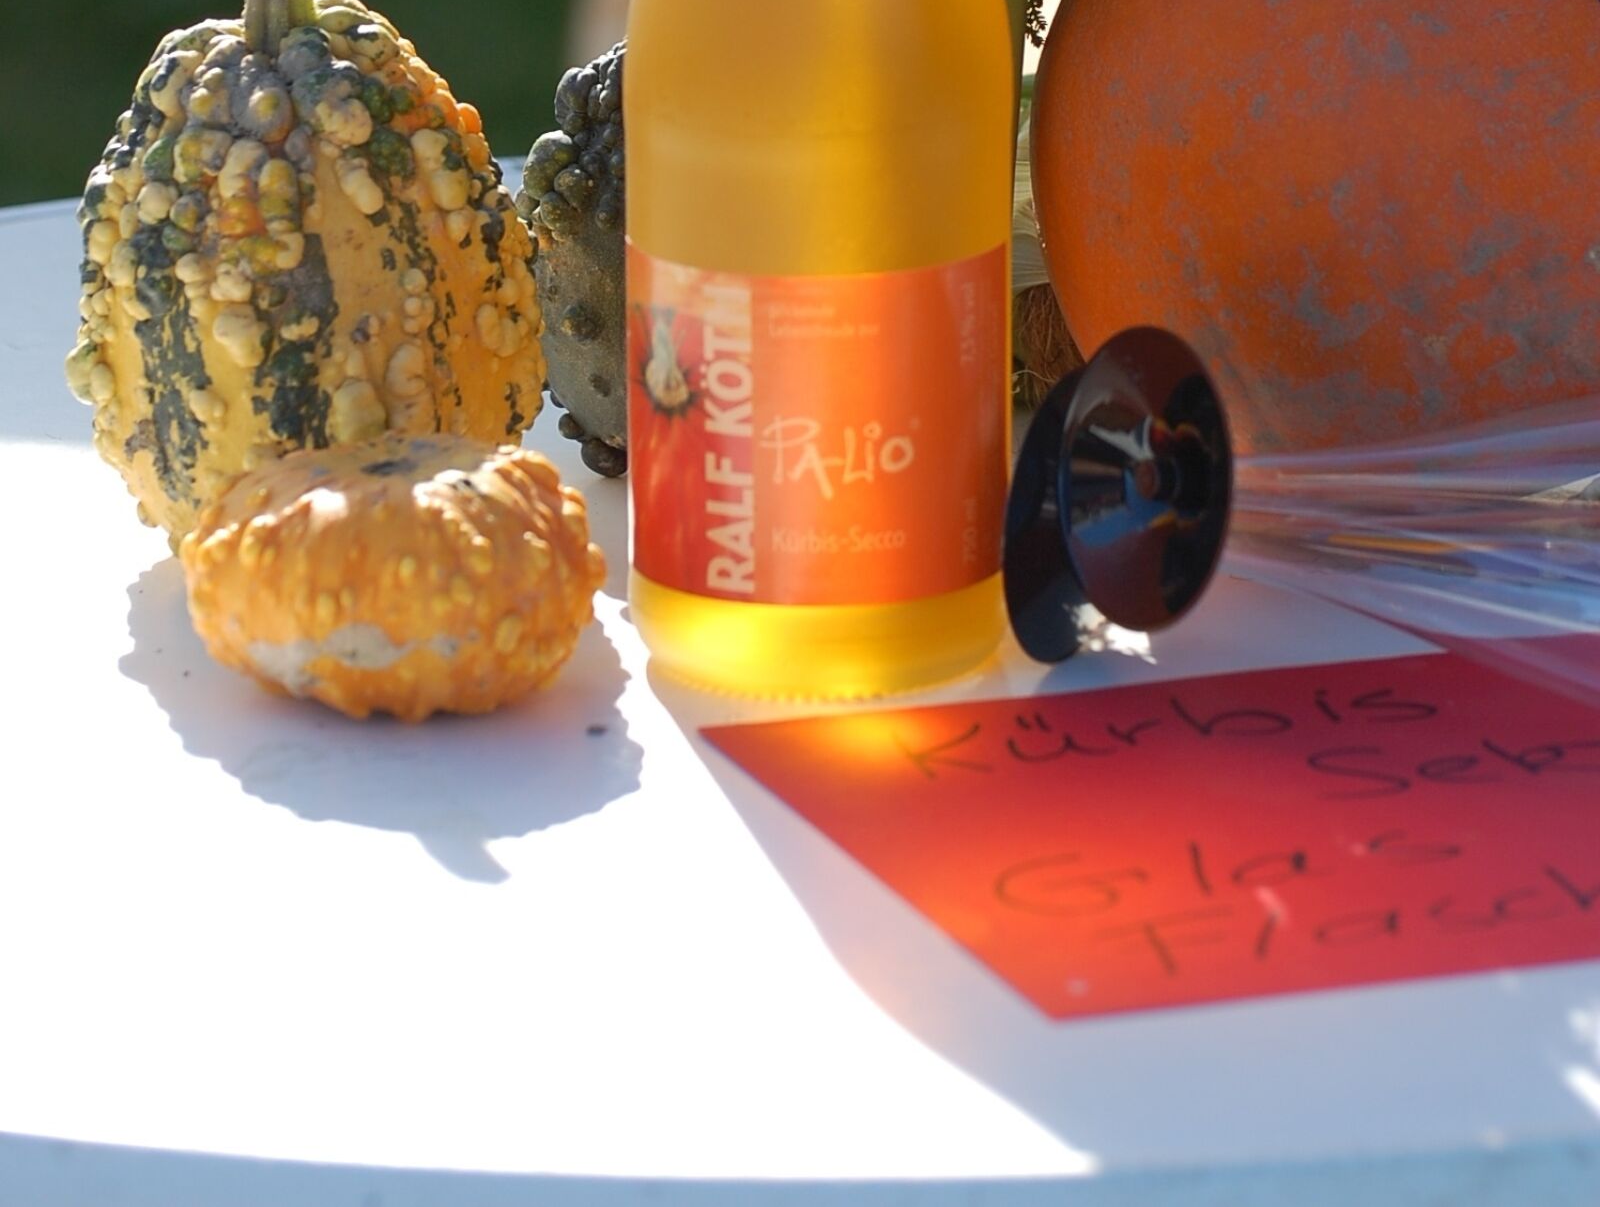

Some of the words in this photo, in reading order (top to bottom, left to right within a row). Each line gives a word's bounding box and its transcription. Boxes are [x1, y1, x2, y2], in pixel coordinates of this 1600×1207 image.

[705, 451, 756, 594] RALF
[900, 687, 1440, 780] Kürbis
[994, 829, 1462, 918] Glas
